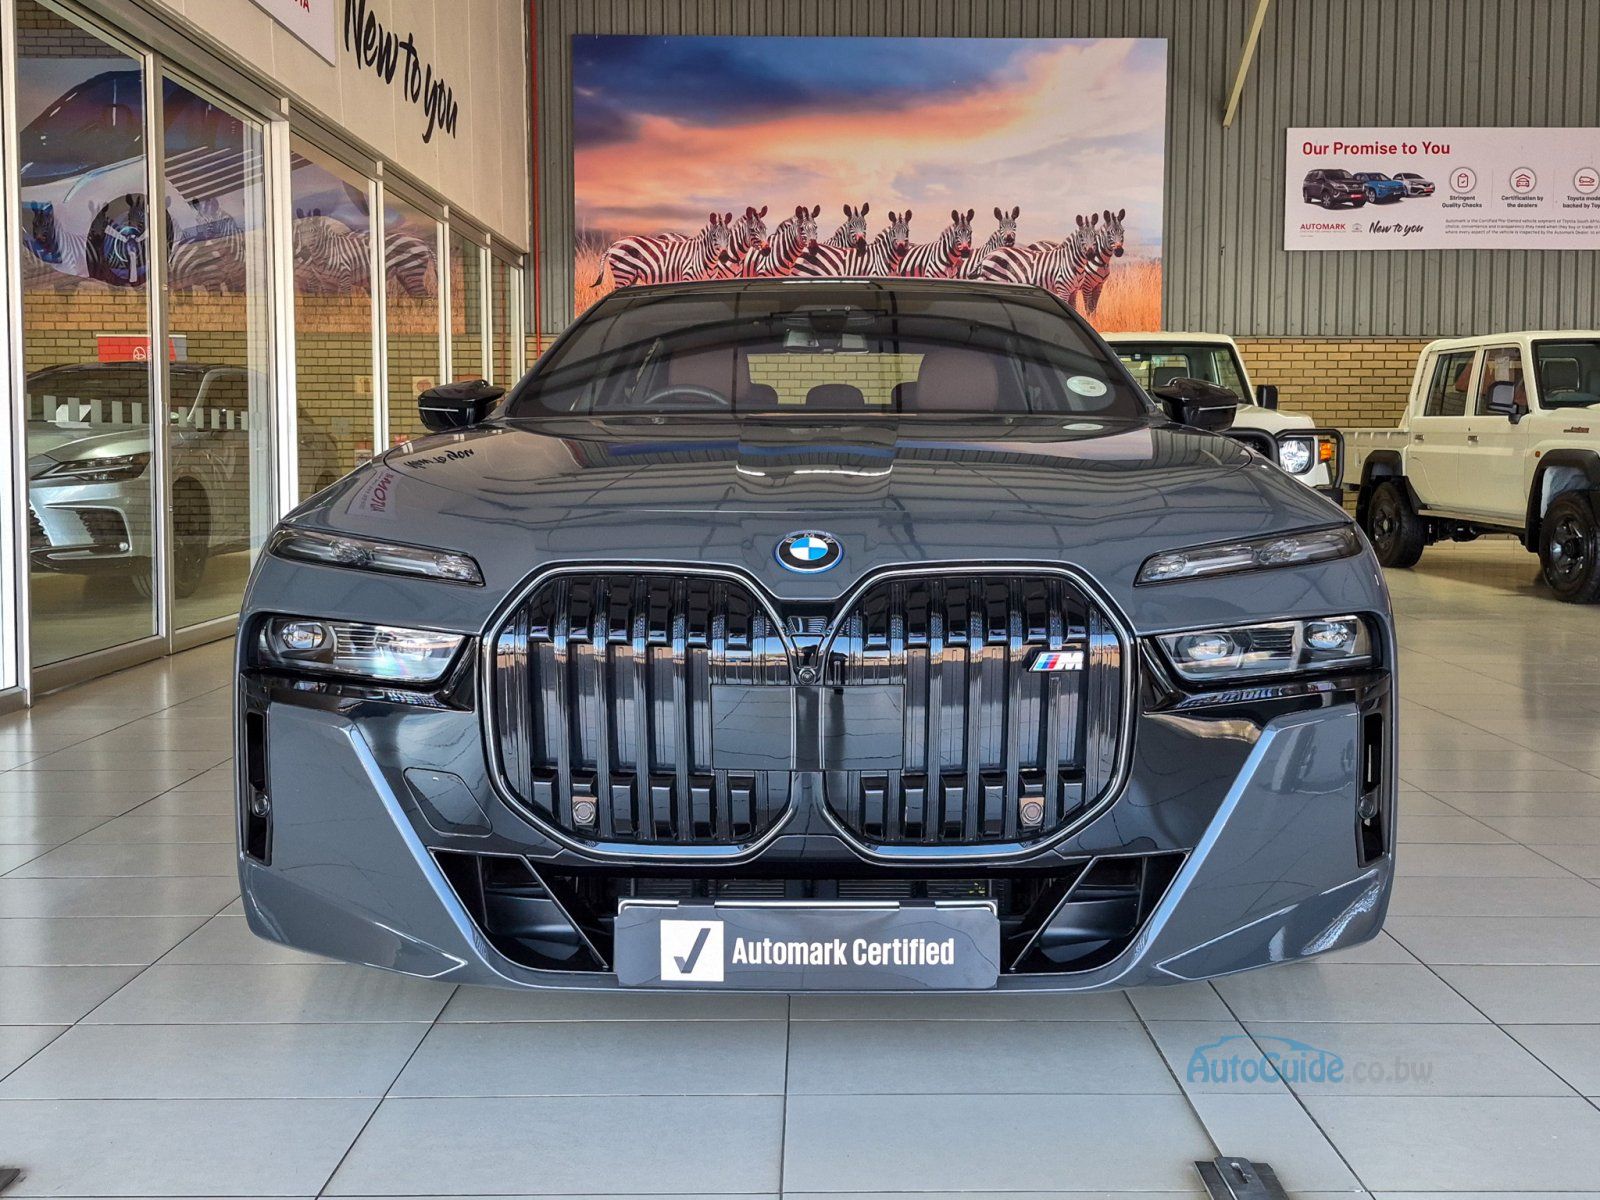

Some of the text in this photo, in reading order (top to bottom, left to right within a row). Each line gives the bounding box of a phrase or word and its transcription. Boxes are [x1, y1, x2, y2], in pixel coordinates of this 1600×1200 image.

[344, 0, 458, 144] New to you
[1302, 141, 1451, 155] Our Promise to You
[1369, 220, 1424, 236] New to you
[732, 937, 955, 966] Automark Certified
